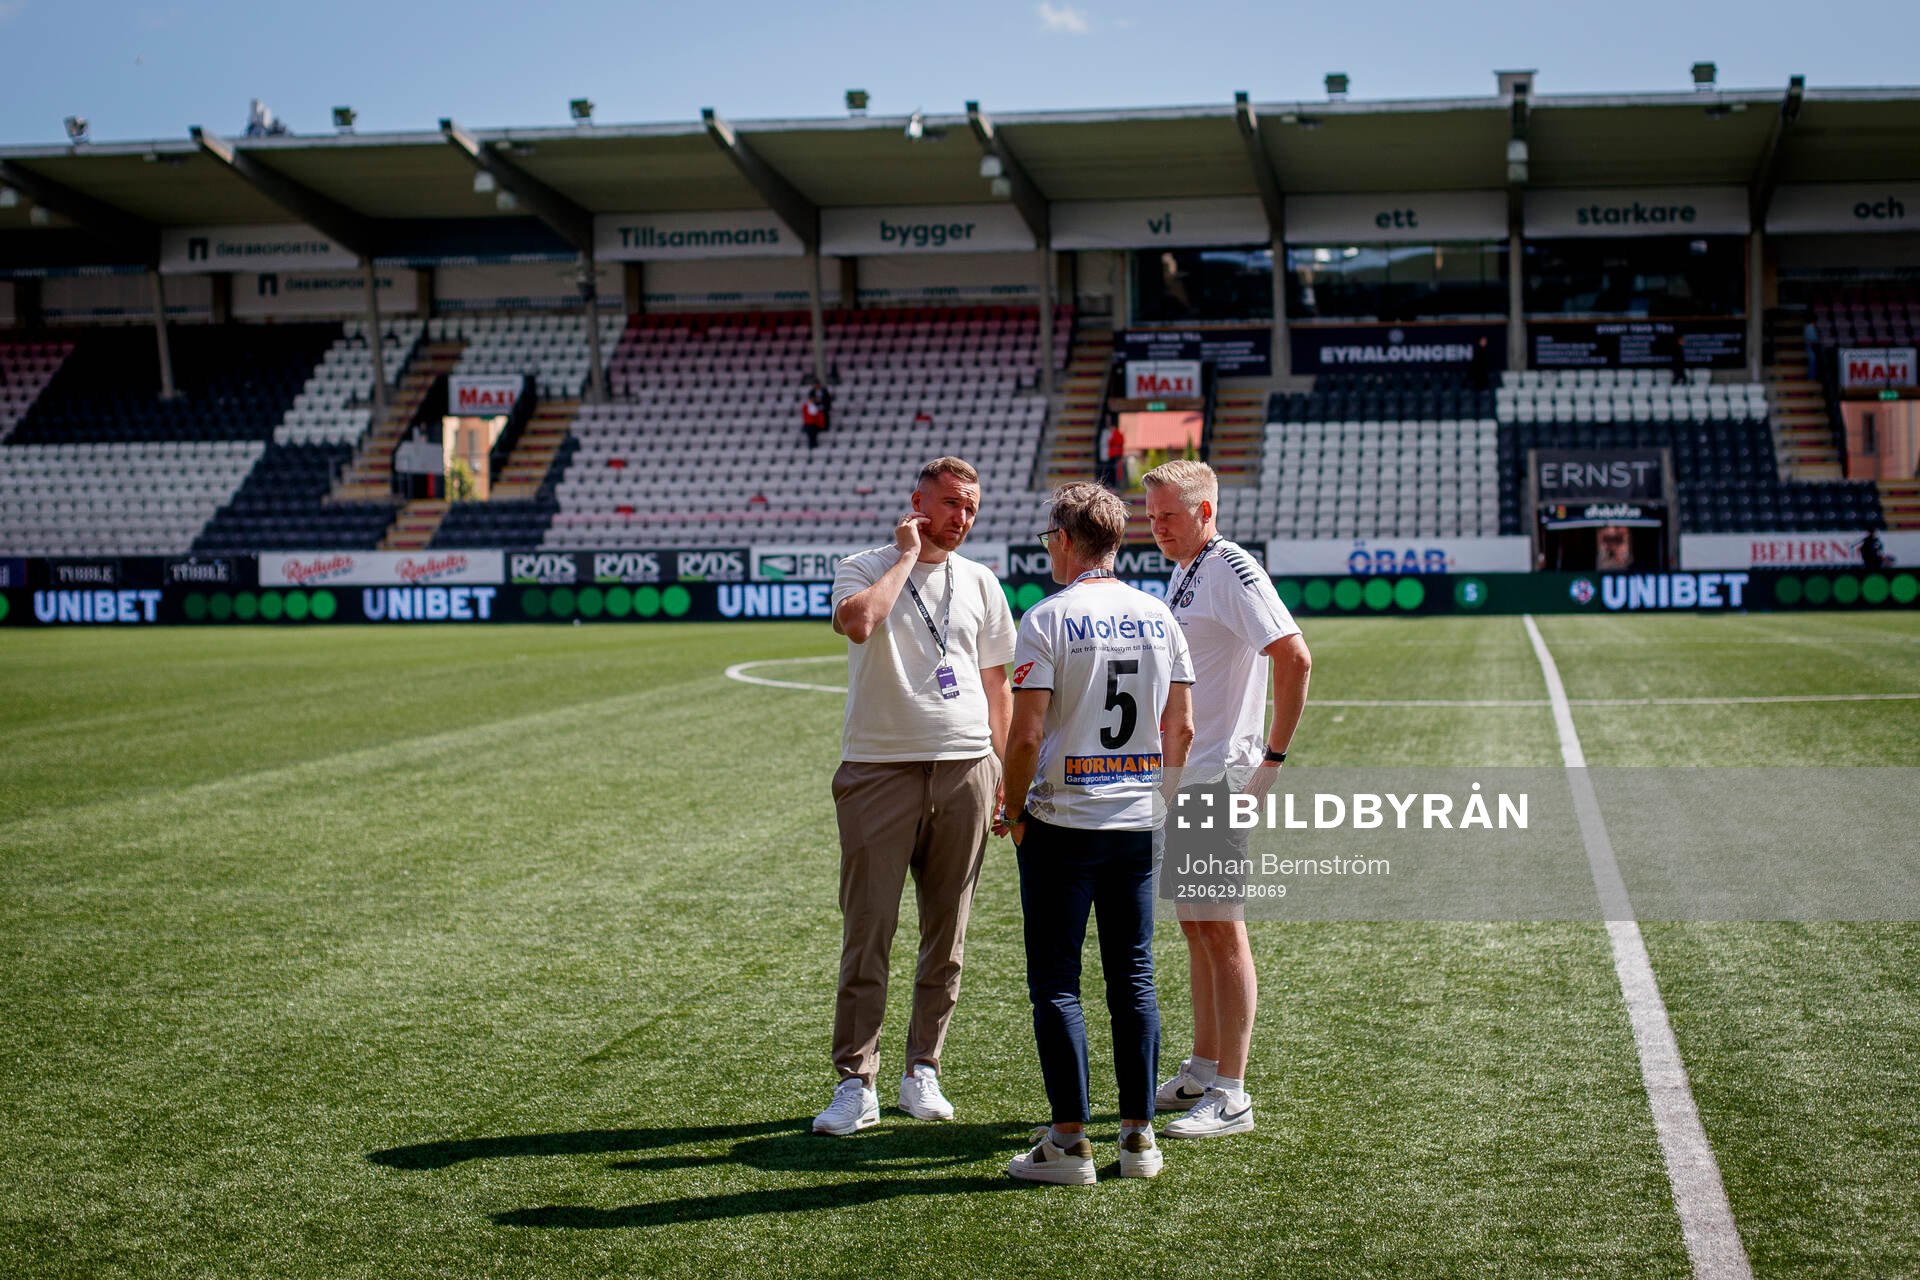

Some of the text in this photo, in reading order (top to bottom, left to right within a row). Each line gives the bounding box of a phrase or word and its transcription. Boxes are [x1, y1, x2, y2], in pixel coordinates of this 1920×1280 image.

[619, 197, 1905, 248] Tillsammans bygger vi ett starkare och
[285, 277, 393, 291] ÖREBROPOREN
[1320, 345, 1473, 363] EYRALOUNGEN
[1541, 461, 1650, 488] ERNST
[1349, 541, 1447, 573] ÖBAB
[34, 590, 162, 622] UNIBET
[363, 587, 496, 620] UNIBET
[717, 584, 832, 617] UNIBE
[1602, 574, 1748, 609] UNIBET
[1065, 615, 1165, 642] Moléns
[1100, 660, 1139, 750] 5
[1066, 757, 1161, 774] HÖRMANN
[1066, 775, 1110, 784] Garagportar
